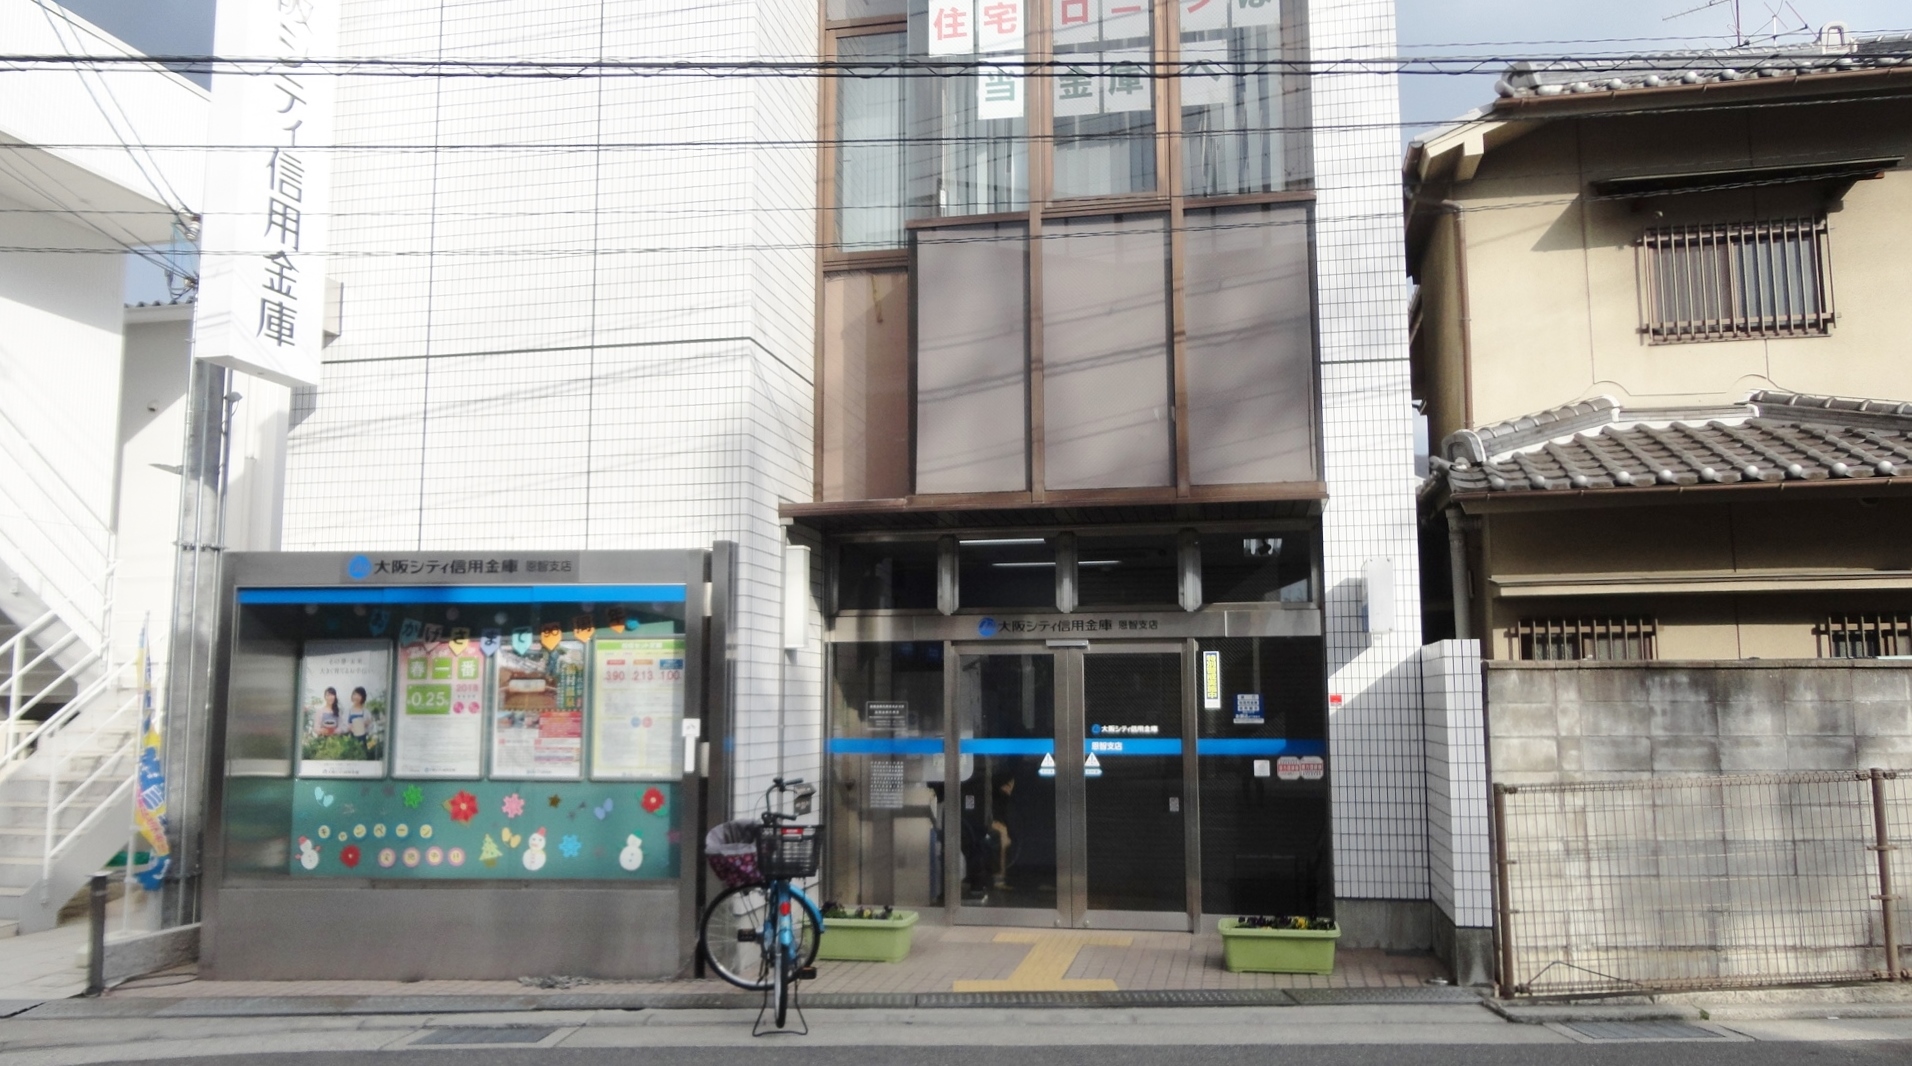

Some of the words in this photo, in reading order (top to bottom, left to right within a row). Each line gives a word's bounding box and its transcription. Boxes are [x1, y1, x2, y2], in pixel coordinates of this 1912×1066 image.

[933, 0, 1271, 41] 住宅ロー
[374, 558, 518, 574] 大阪シティ信用金庫
[526, 560, 572, 573] 恩智支店
[998, 619, 1112, 633] 大阪シティ信用金庫
[1118, 619, 1158, 631] 恩智支店
